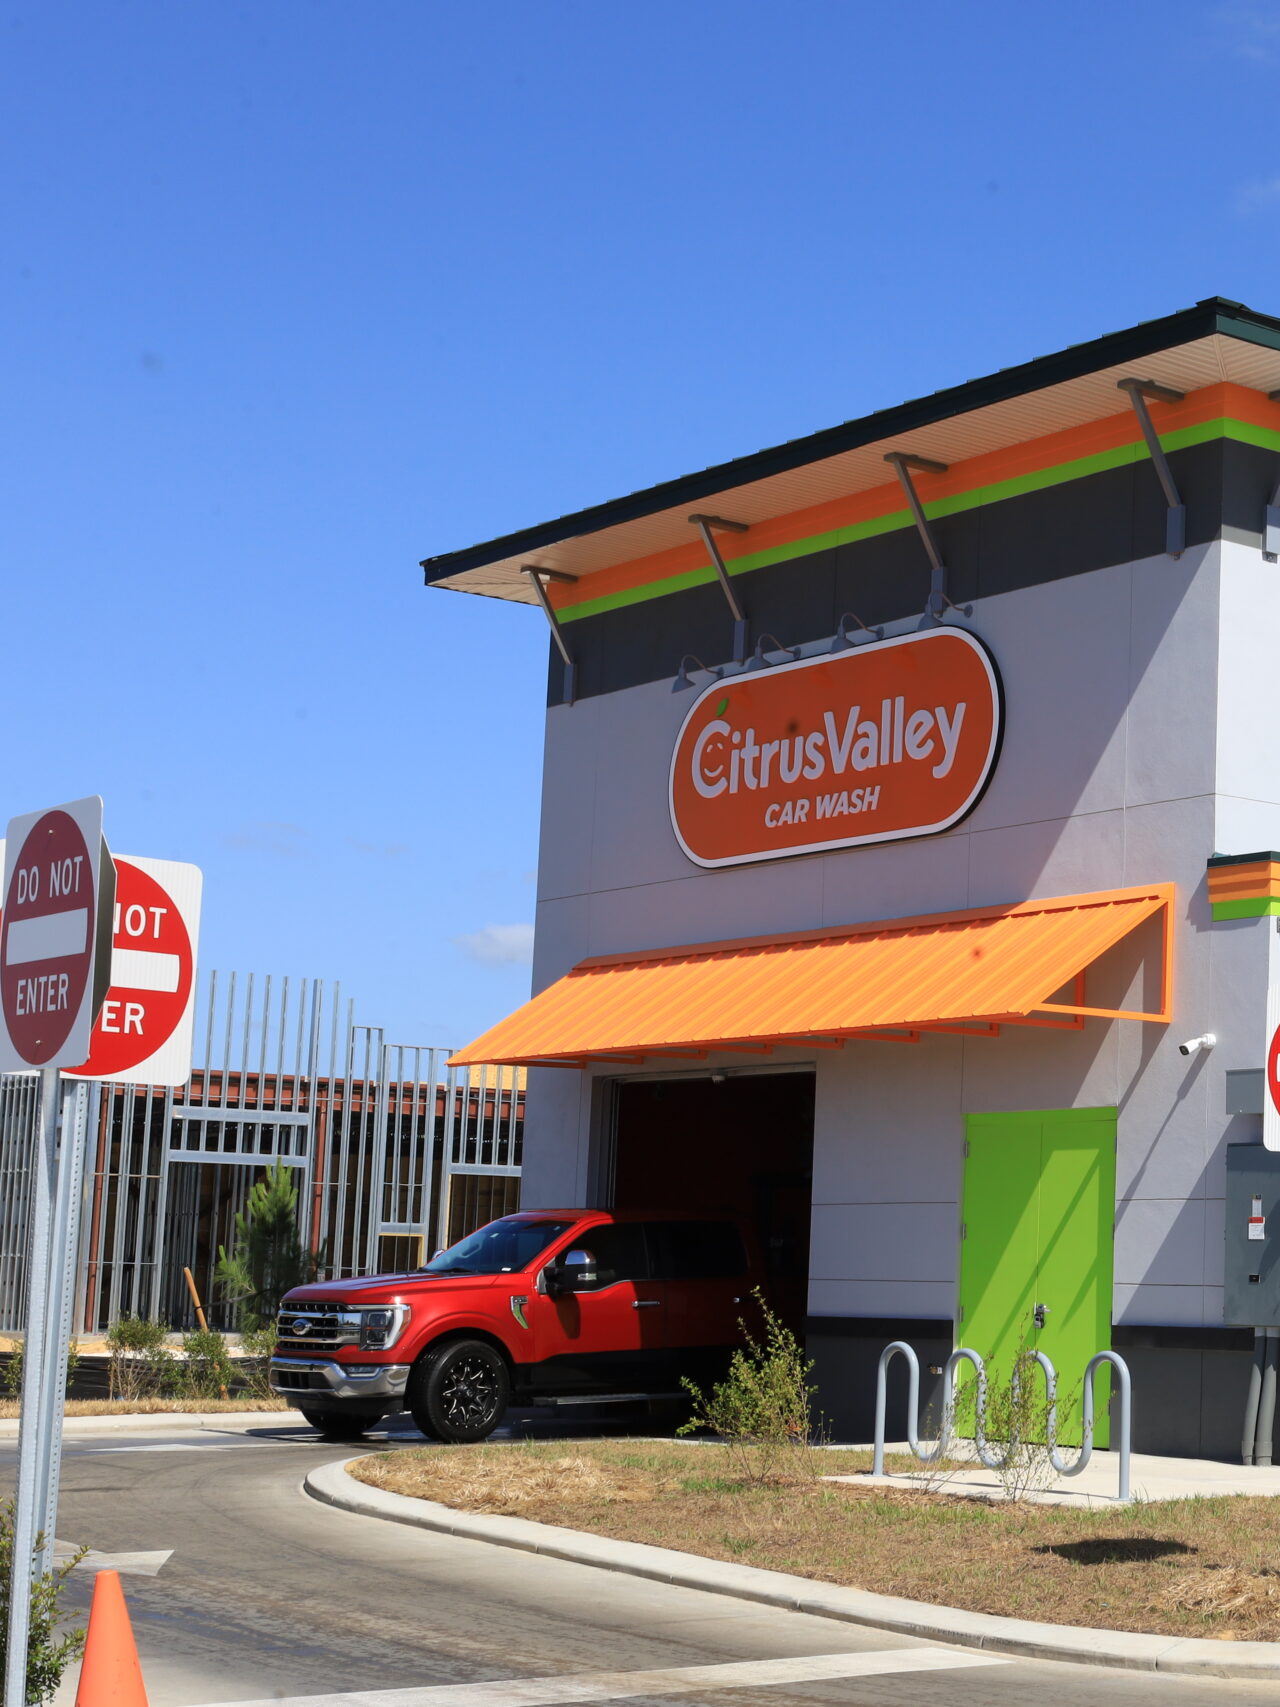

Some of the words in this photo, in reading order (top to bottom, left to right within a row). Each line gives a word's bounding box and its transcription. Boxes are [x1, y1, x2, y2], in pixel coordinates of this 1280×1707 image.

[691, 696, 966, 799] CitrusValley
[765, 798, 810, 828] CAR
[816, 785, 881, 820] WASH
[17, 865, 39, 905] DO
[49, 855, 83, 898] NOT
[16, 973, 69, 1016] ENTER
